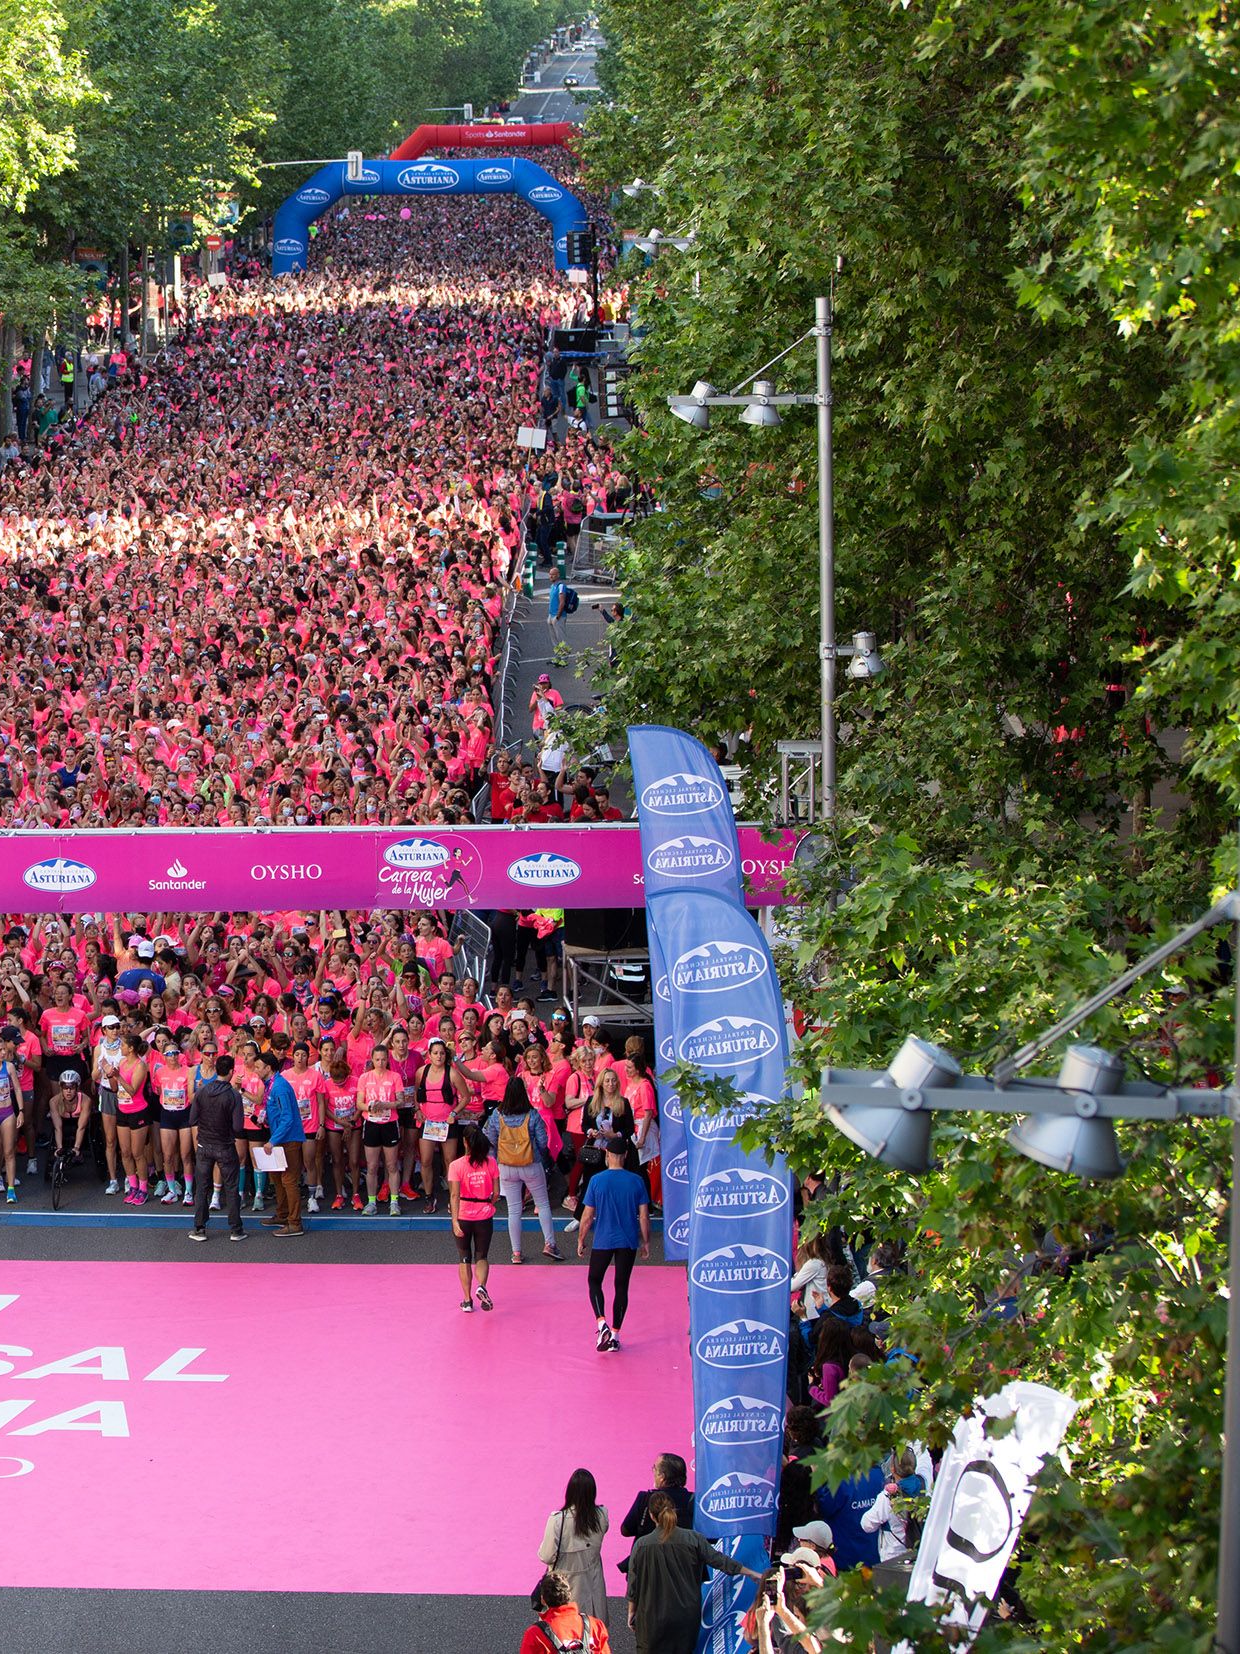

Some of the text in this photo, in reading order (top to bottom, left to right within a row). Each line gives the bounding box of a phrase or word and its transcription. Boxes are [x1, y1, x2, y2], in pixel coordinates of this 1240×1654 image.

[494, 130, 526, 138] Santander
[403, 173, 454, 184] ASTURIANA
[389, 850, 445, 862] ASTURIANA
[29, 871, 91, 884] ASTURIANA
[250, 864, 323, 880] OYSHO
[378, 866, 433, 883] Carrera
[513, 865, 576, 878] ASTURIANA
[148, 879, 206, 891] Santander
[392, 880, 453, 907] de la Mujer
